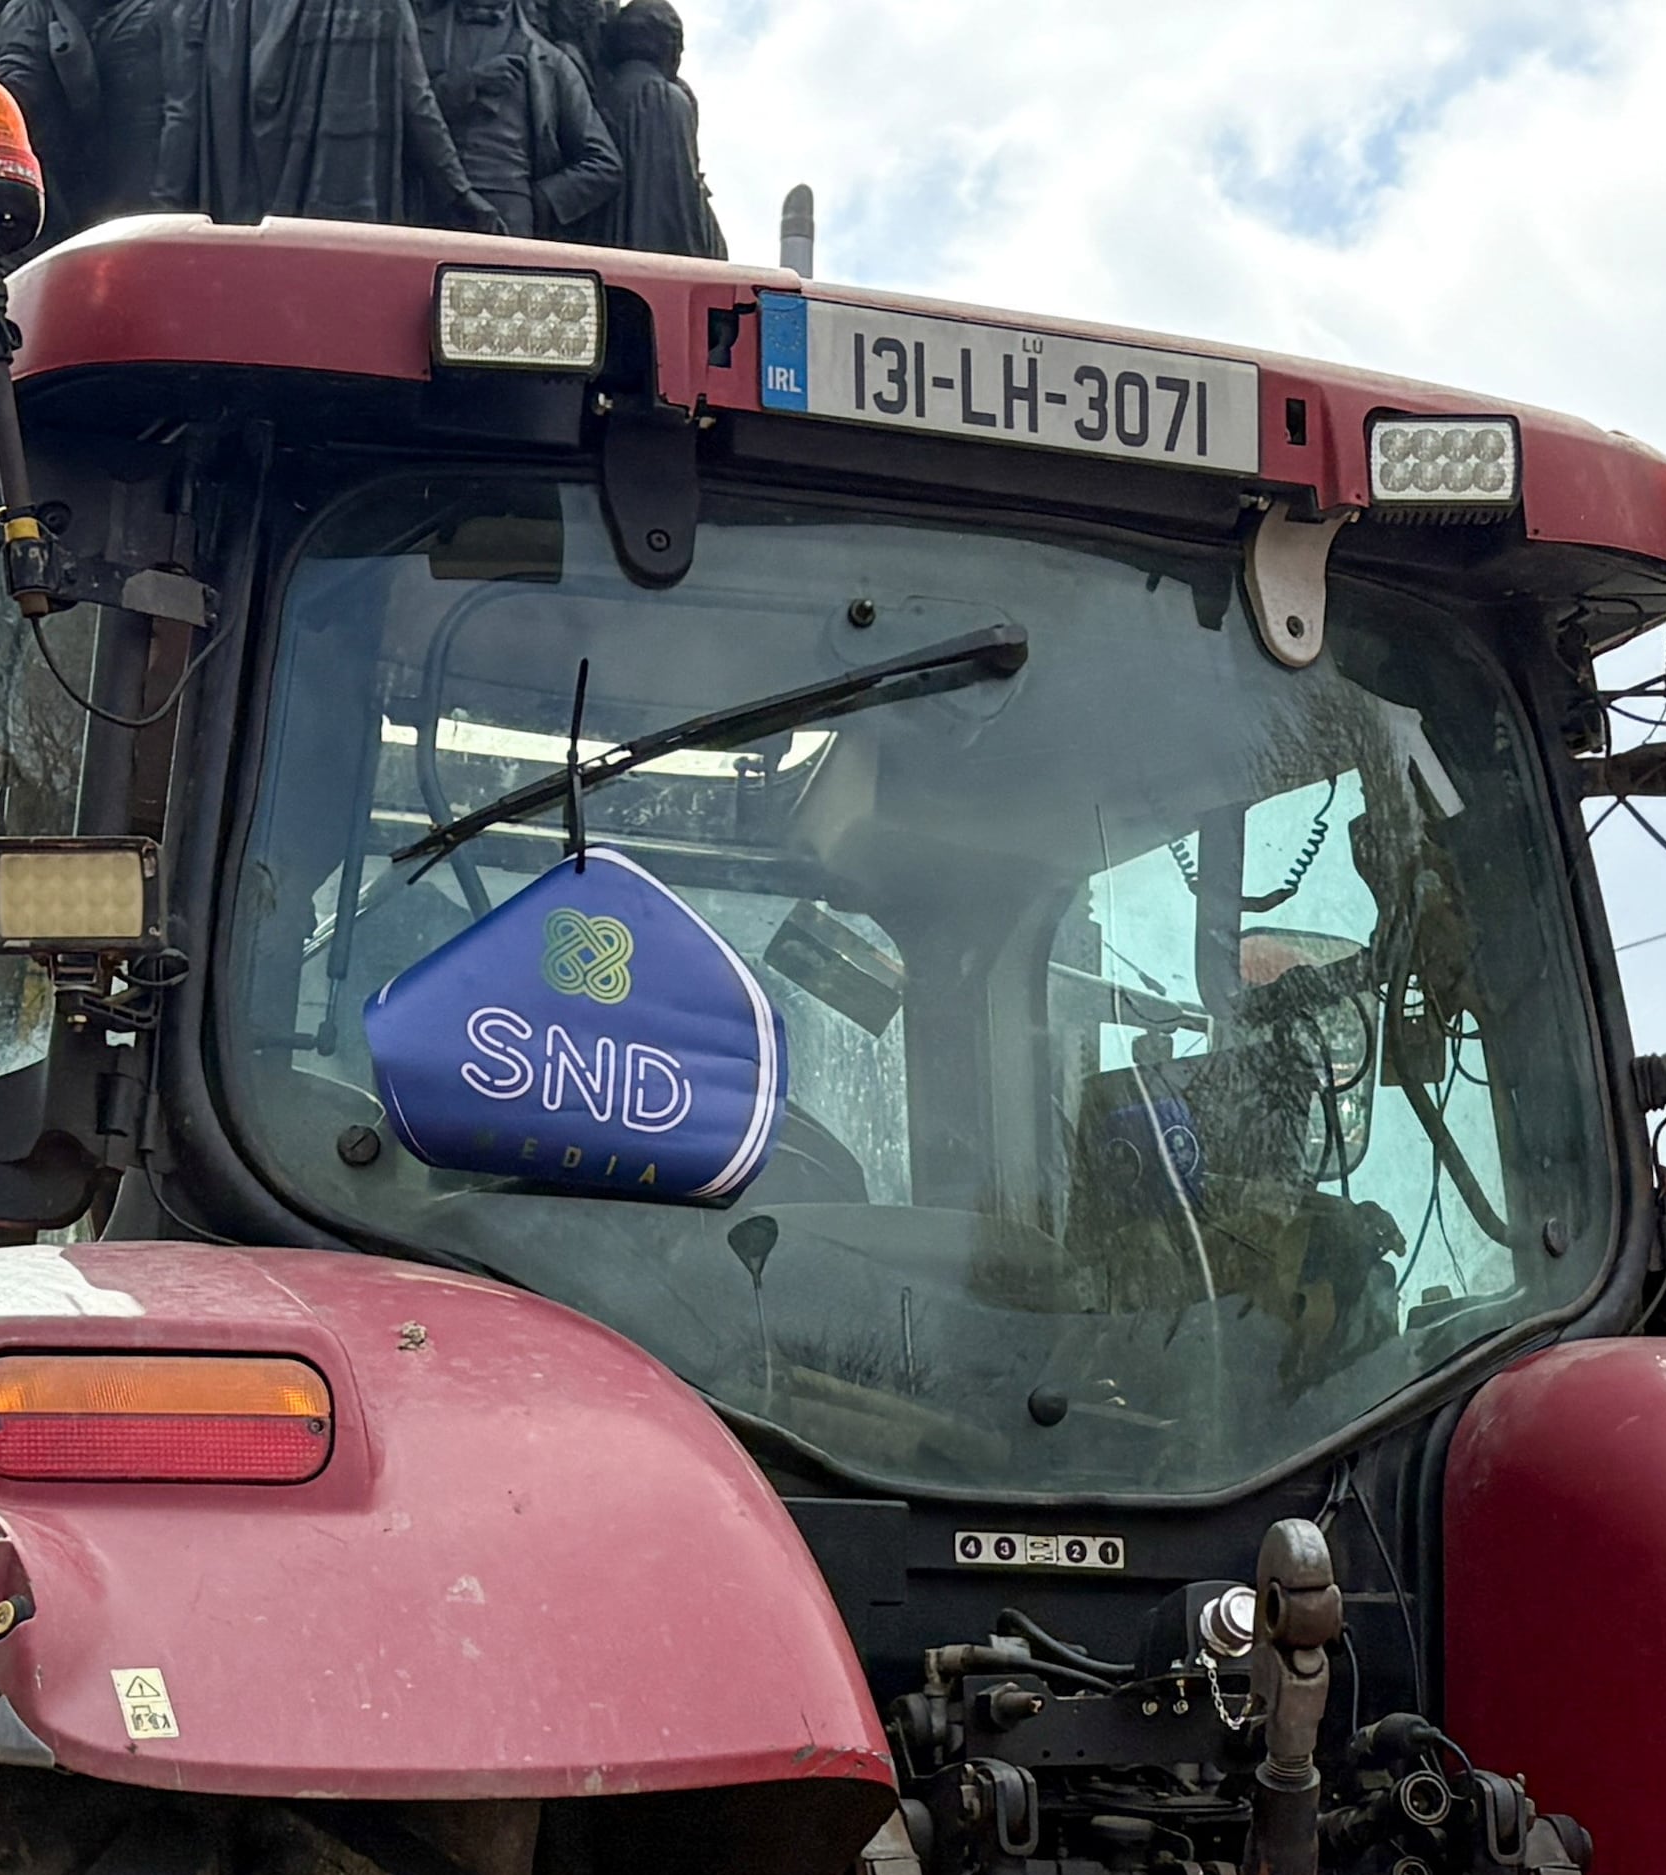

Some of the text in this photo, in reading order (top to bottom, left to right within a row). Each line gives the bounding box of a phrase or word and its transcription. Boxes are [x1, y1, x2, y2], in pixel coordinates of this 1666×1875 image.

[766, 363, 803, 395] IRL
[853, 332, 1208, 457] 131-LH-3071
[460, 1007, 692, 1134] SND
